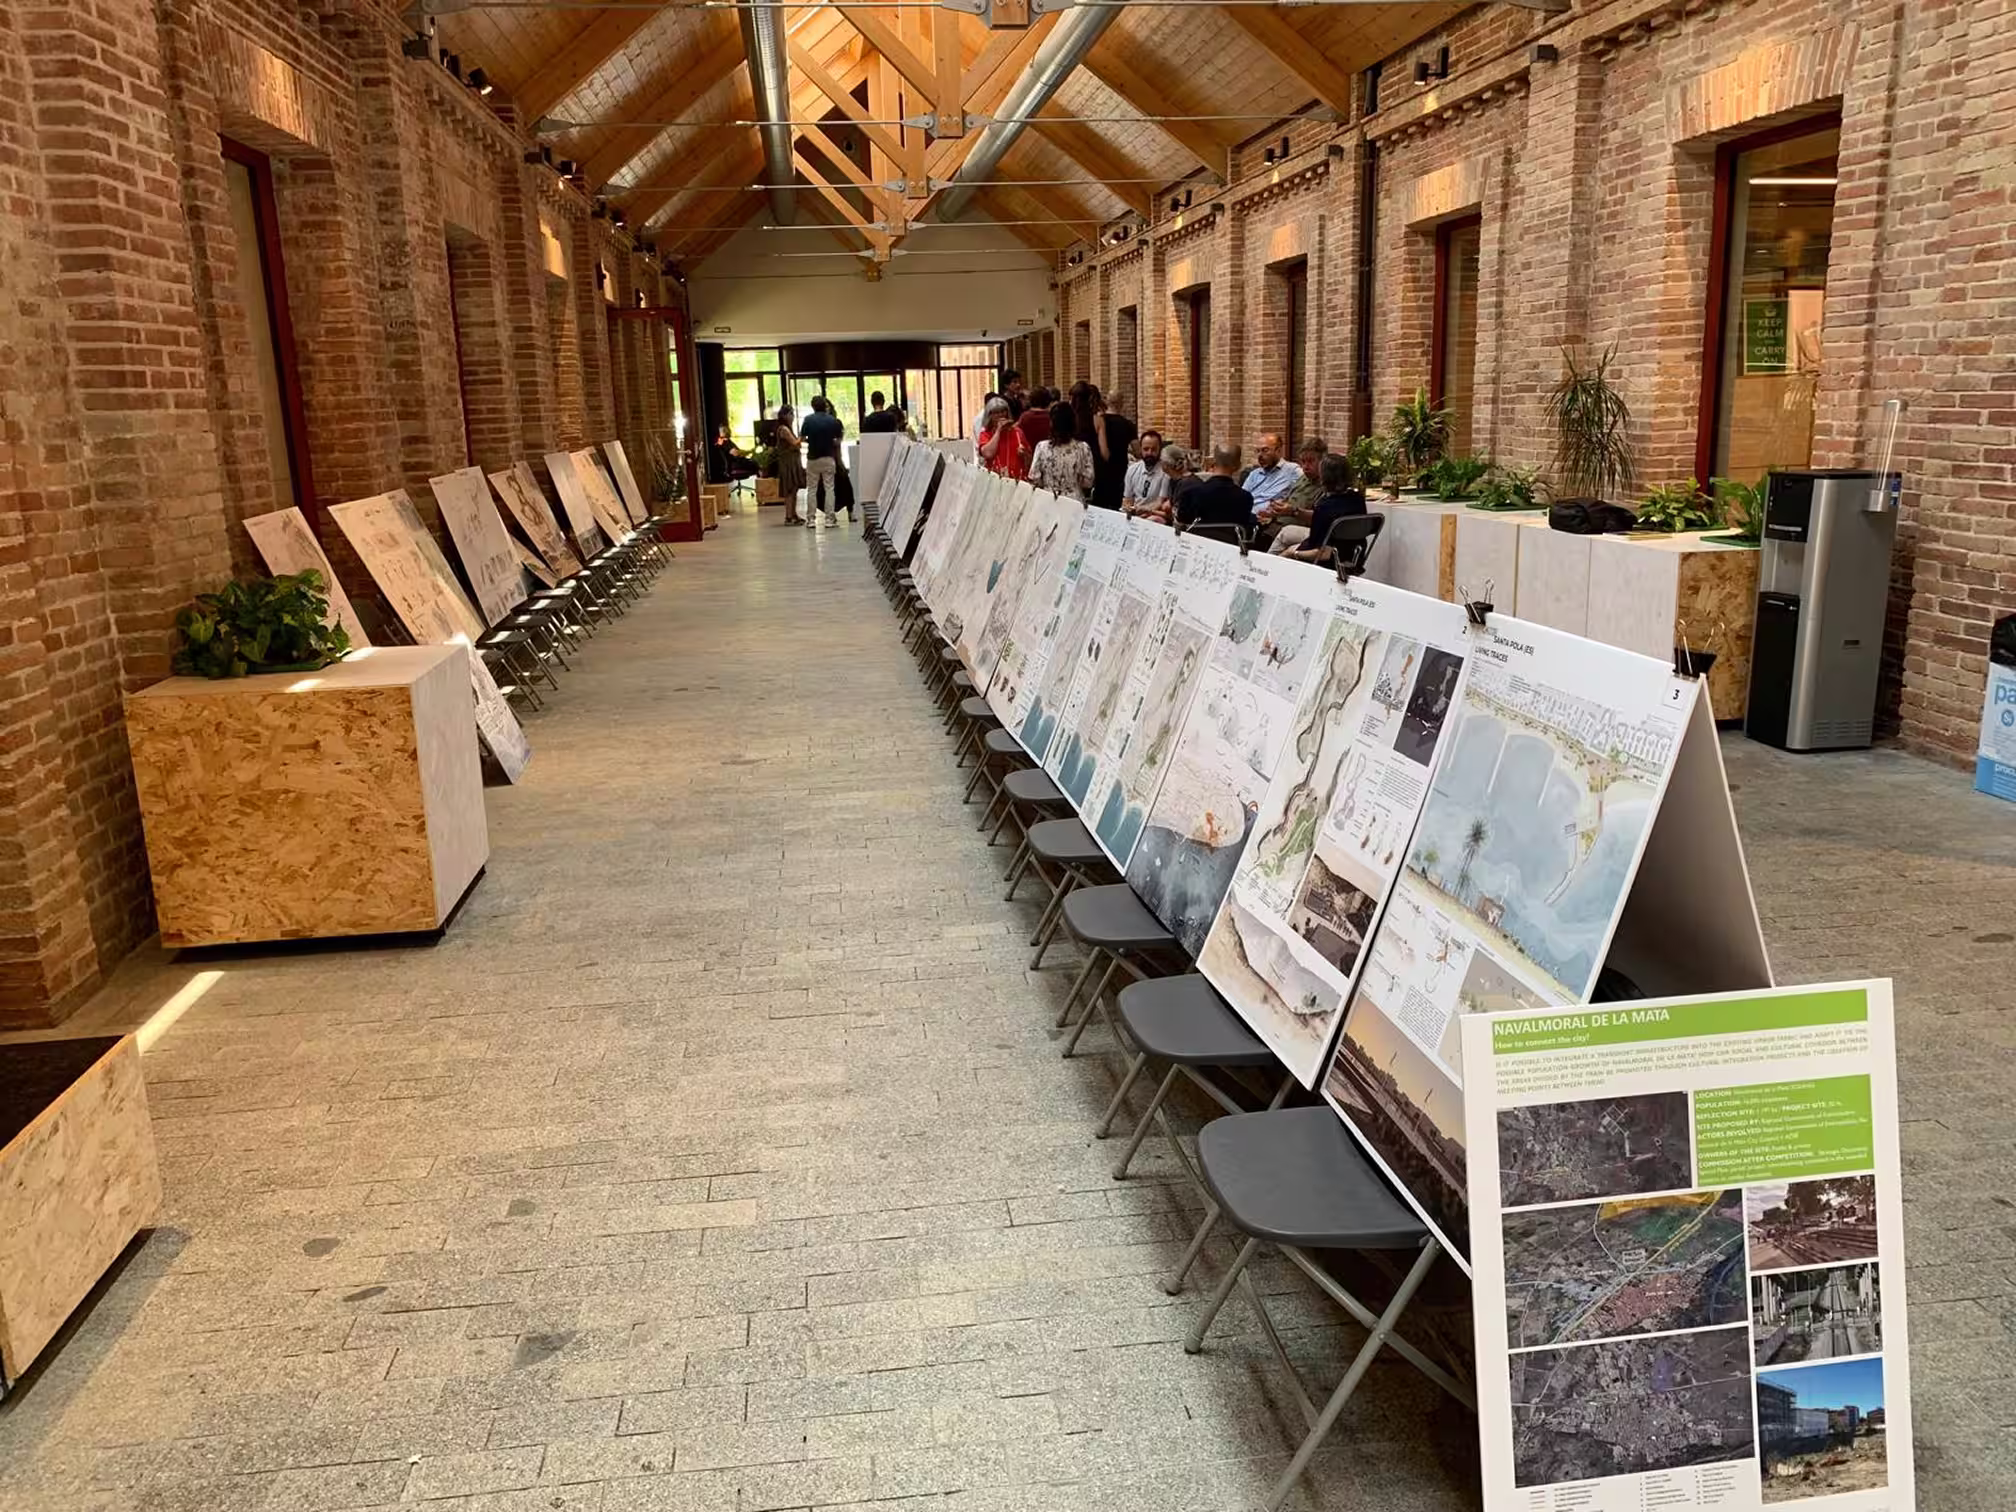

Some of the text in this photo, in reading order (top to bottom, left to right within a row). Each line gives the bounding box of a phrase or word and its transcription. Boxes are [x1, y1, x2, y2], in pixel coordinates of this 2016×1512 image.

[1758, 318, 1782, 328] KEEP
[1756, 329, 1784, 338] CALM
[1754, 345, 1785, 355] CARRY
[1462, 625, 1468, 635] 2
[1493, 635, 1510, 647] SANTA
[1509, 640, 1524, 652] POLA
[1474, 645, 1490, 657] LIVING
[1490, 650, 1509, 663] TRACES
[1672, 688, 1680, 701] 3
[1494, 1008, 1670, 1036] NAVALMORAL DE LA MATA
[1494, 1040, 1512, 1049] How
[1514, 1040, 1522, 1048] to
[1525, 1037, 1556, 1046] connect
[1552, 1053, 1588, 1062] INTEGRATE
[1526, 1064, 1568, 1073] POPULATION
[1552, 1081, 1582, 1089] BETWEEN
[1697, 1130, 1724, 1139] ACTORS
